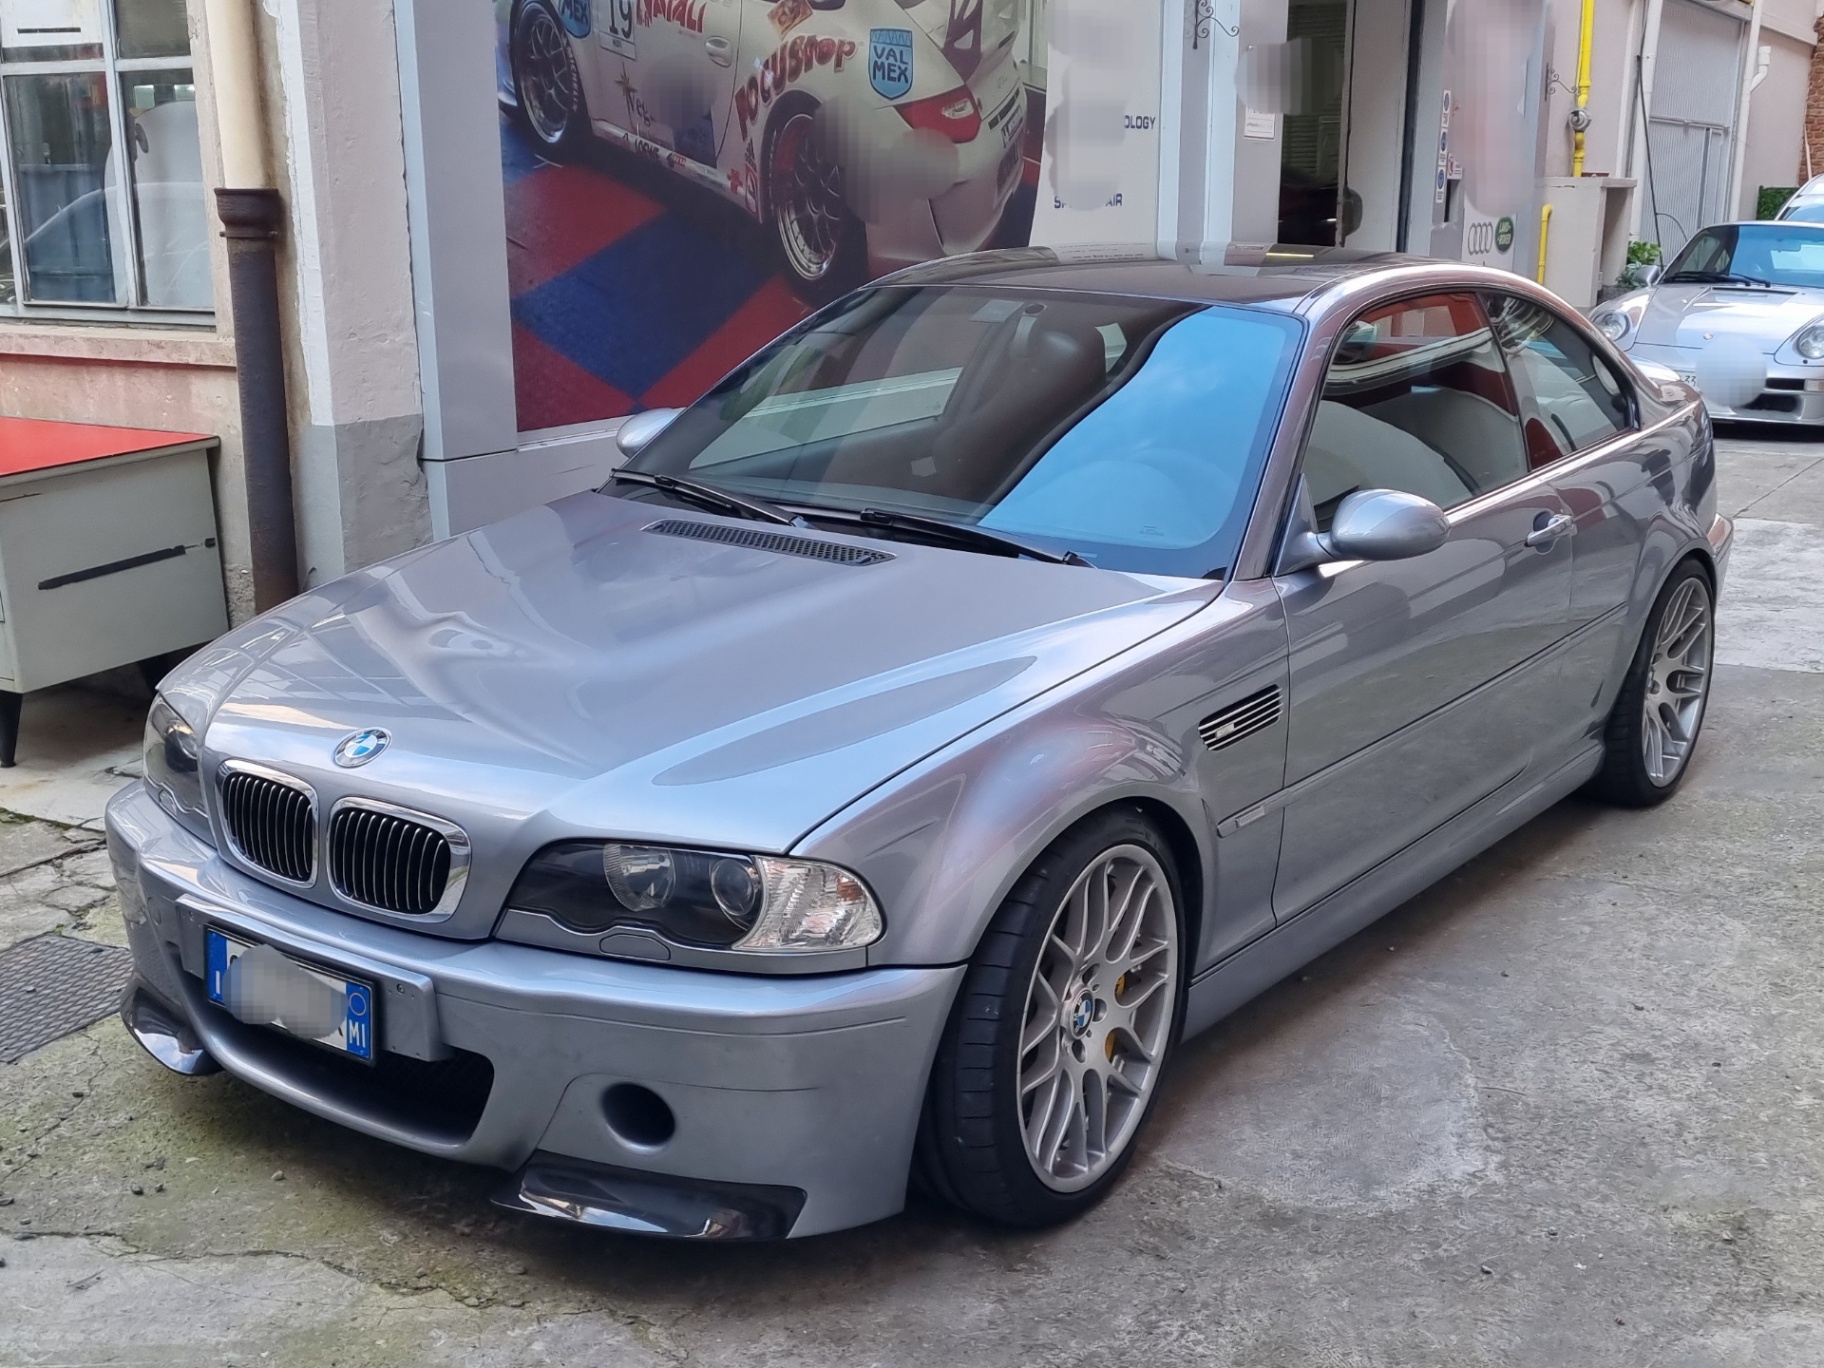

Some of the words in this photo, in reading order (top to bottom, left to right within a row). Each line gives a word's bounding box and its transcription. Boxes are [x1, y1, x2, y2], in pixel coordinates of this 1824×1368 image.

[873, 45, 908, 65] VAL
[872, 60, 908, 84] MEX
[349, 1019, 366, 1048] MI
